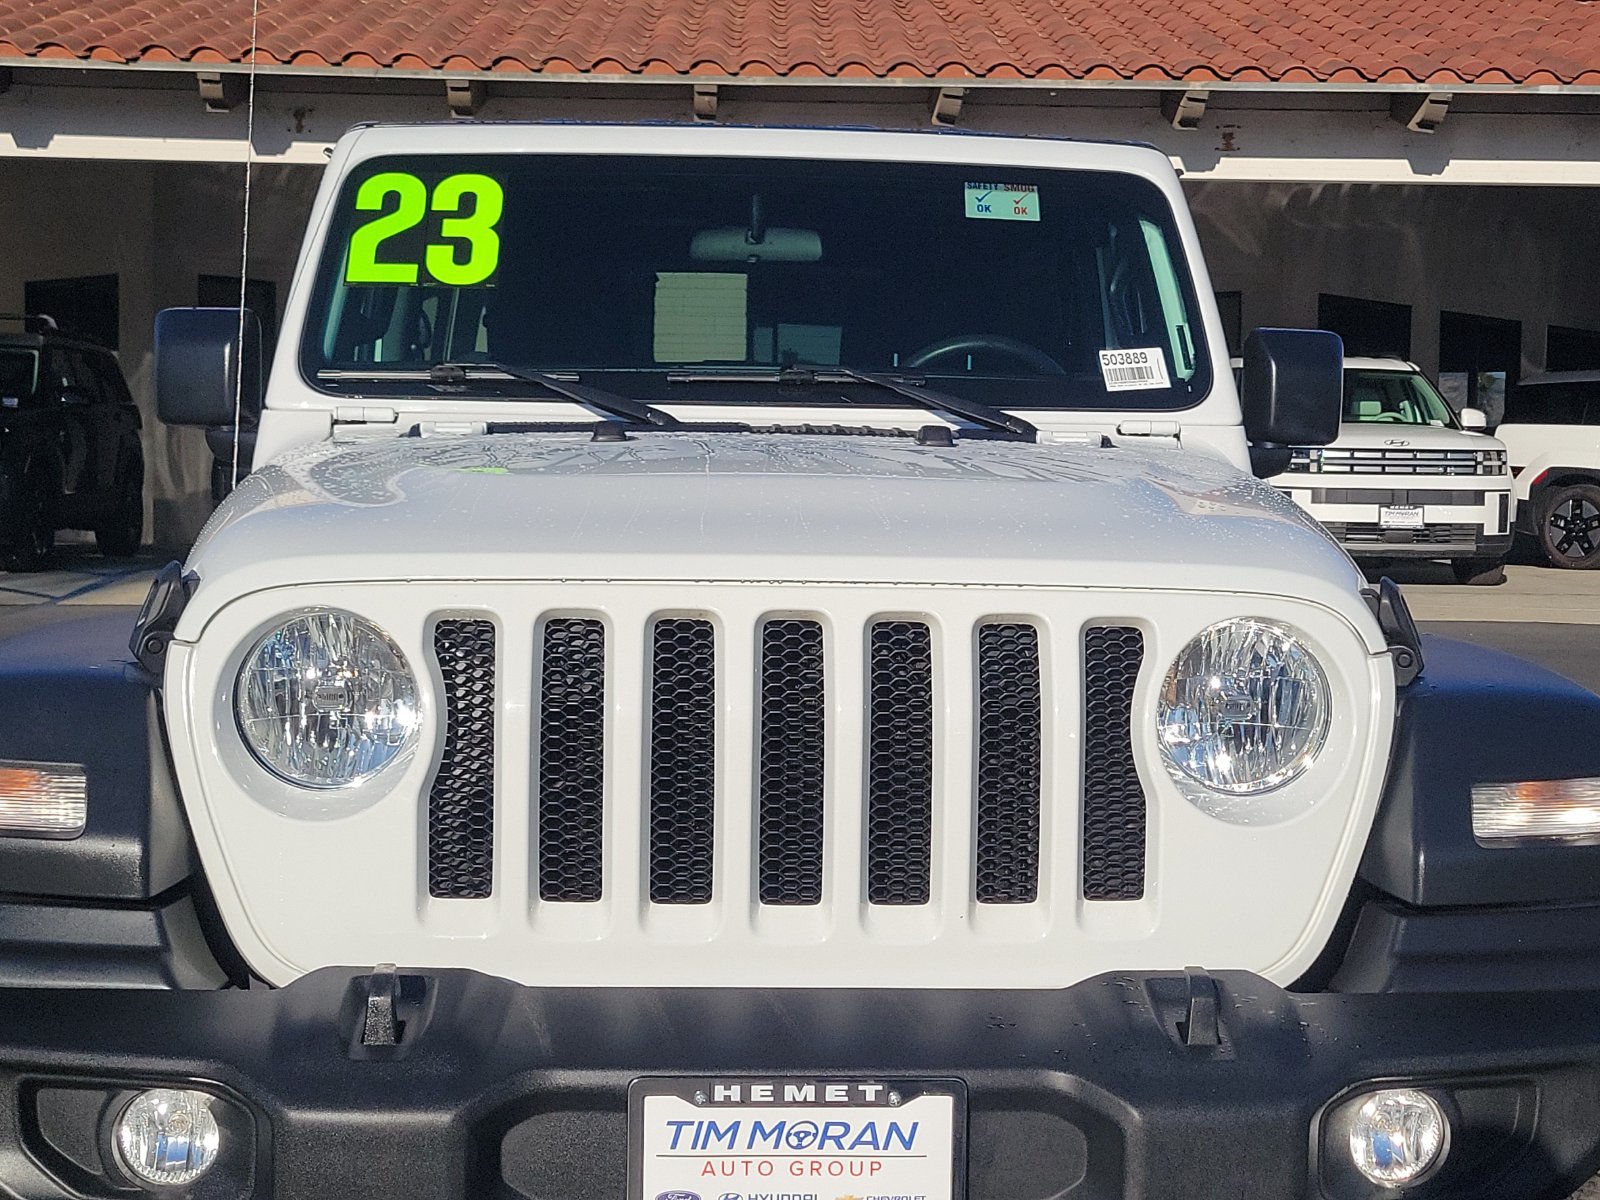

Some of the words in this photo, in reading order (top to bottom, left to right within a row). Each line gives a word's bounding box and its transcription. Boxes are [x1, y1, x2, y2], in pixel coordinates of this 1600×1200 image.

[966, 182, 998, 191] SAFETY
[1003, 184, 1036, 193] SMOG
[977, 204, 992, 213] OK
[1014, 206, 1028, 215] OK
[346, 172, 504, 285] 23
[1101, 351, 1148, 366] 503889
[714, 1084, 884, 1102] HEMET
[665, 1120, 742, 1150] TIM
[746, 1120, 919, 1150] MORAN
[701, 1160, 774, 1177] AUTO
[789, 1160, 882, 1177] GROUP
